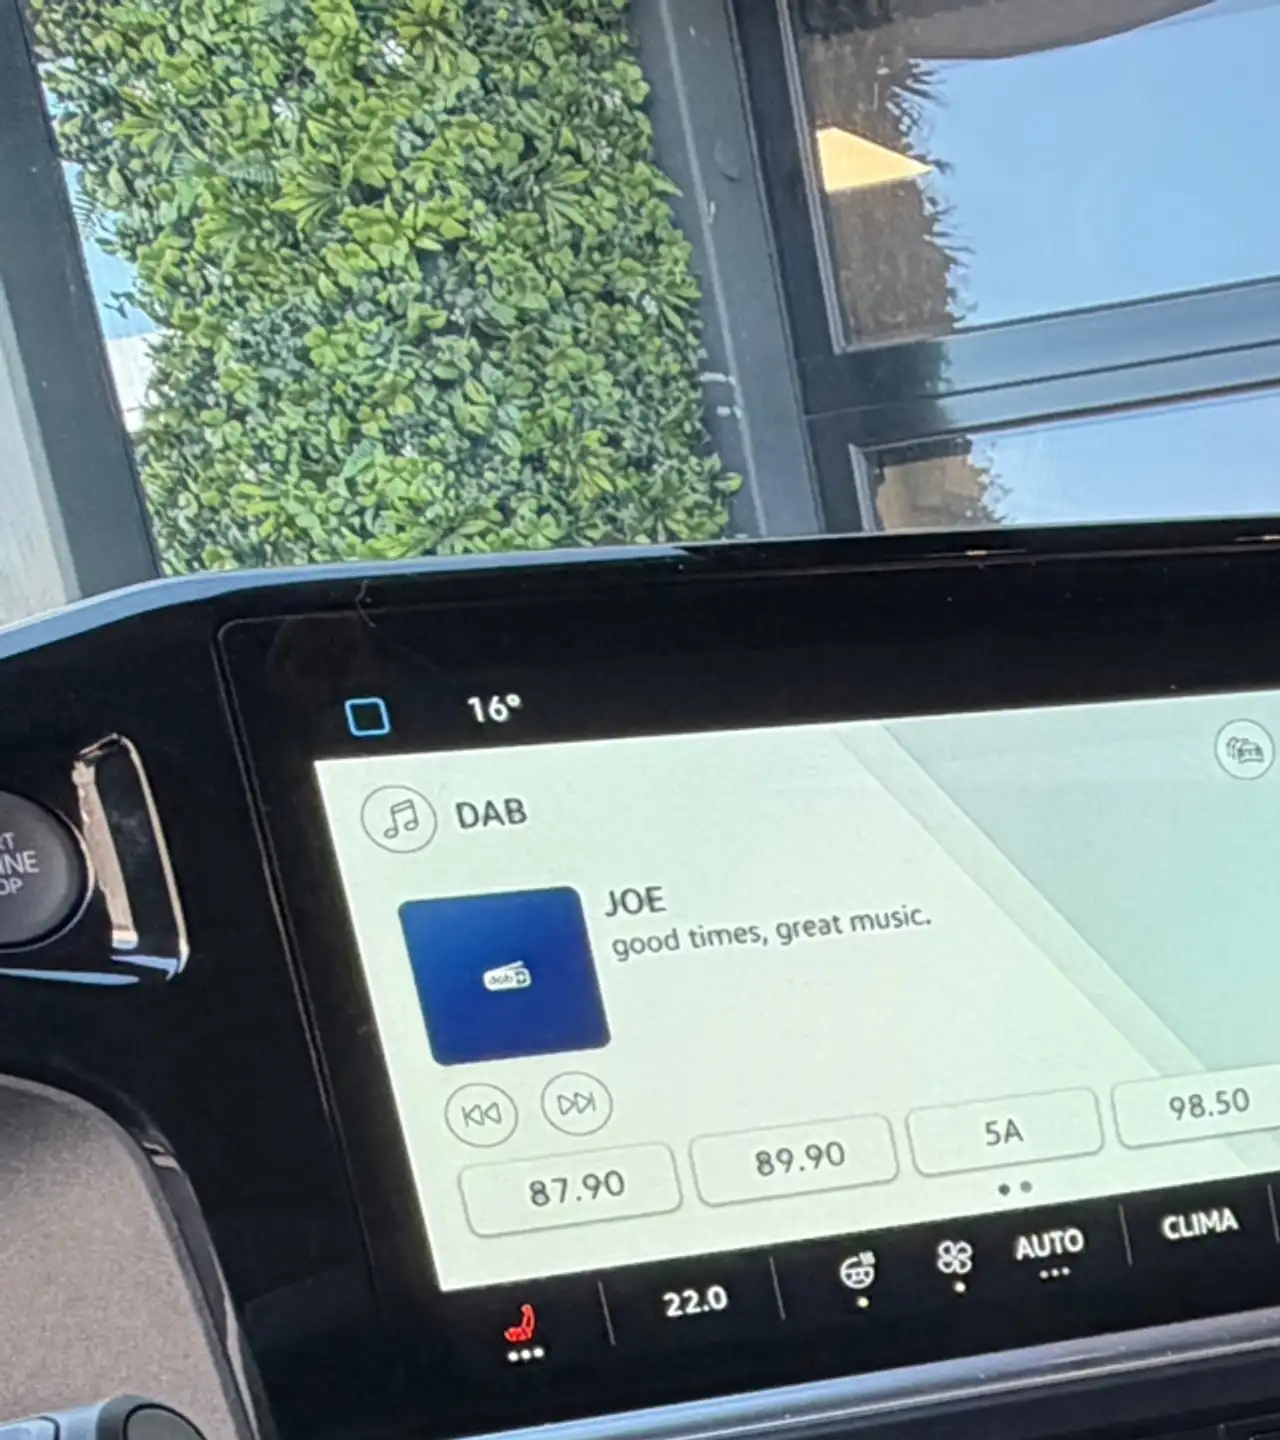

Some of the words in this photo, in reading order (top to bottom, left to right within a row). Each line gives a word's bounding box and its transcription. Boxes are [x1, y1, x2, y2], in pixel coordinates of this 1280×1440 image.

[455, 799, 528, 829] DAB
[604, 886, 666, 917] JOE
[612, 930, 682, 962] good
[689, 924, 769, 948] times,
[775, 914, 844, 942] great
[850, 905, 932, 930] music.
[1168, 1089, 1251, 1121] 98.50
[984, 1118, 1024, 1147] 5A
[755, 1142, 846, 1177] 89.90
[529, 1171, 626, 1207] 87.90
[1161, 1208, 1239, 1241] CLIMA
[1014, 1228, 1085, 1262] AUTO
[662, 1285, 729, 1317] 22.0
